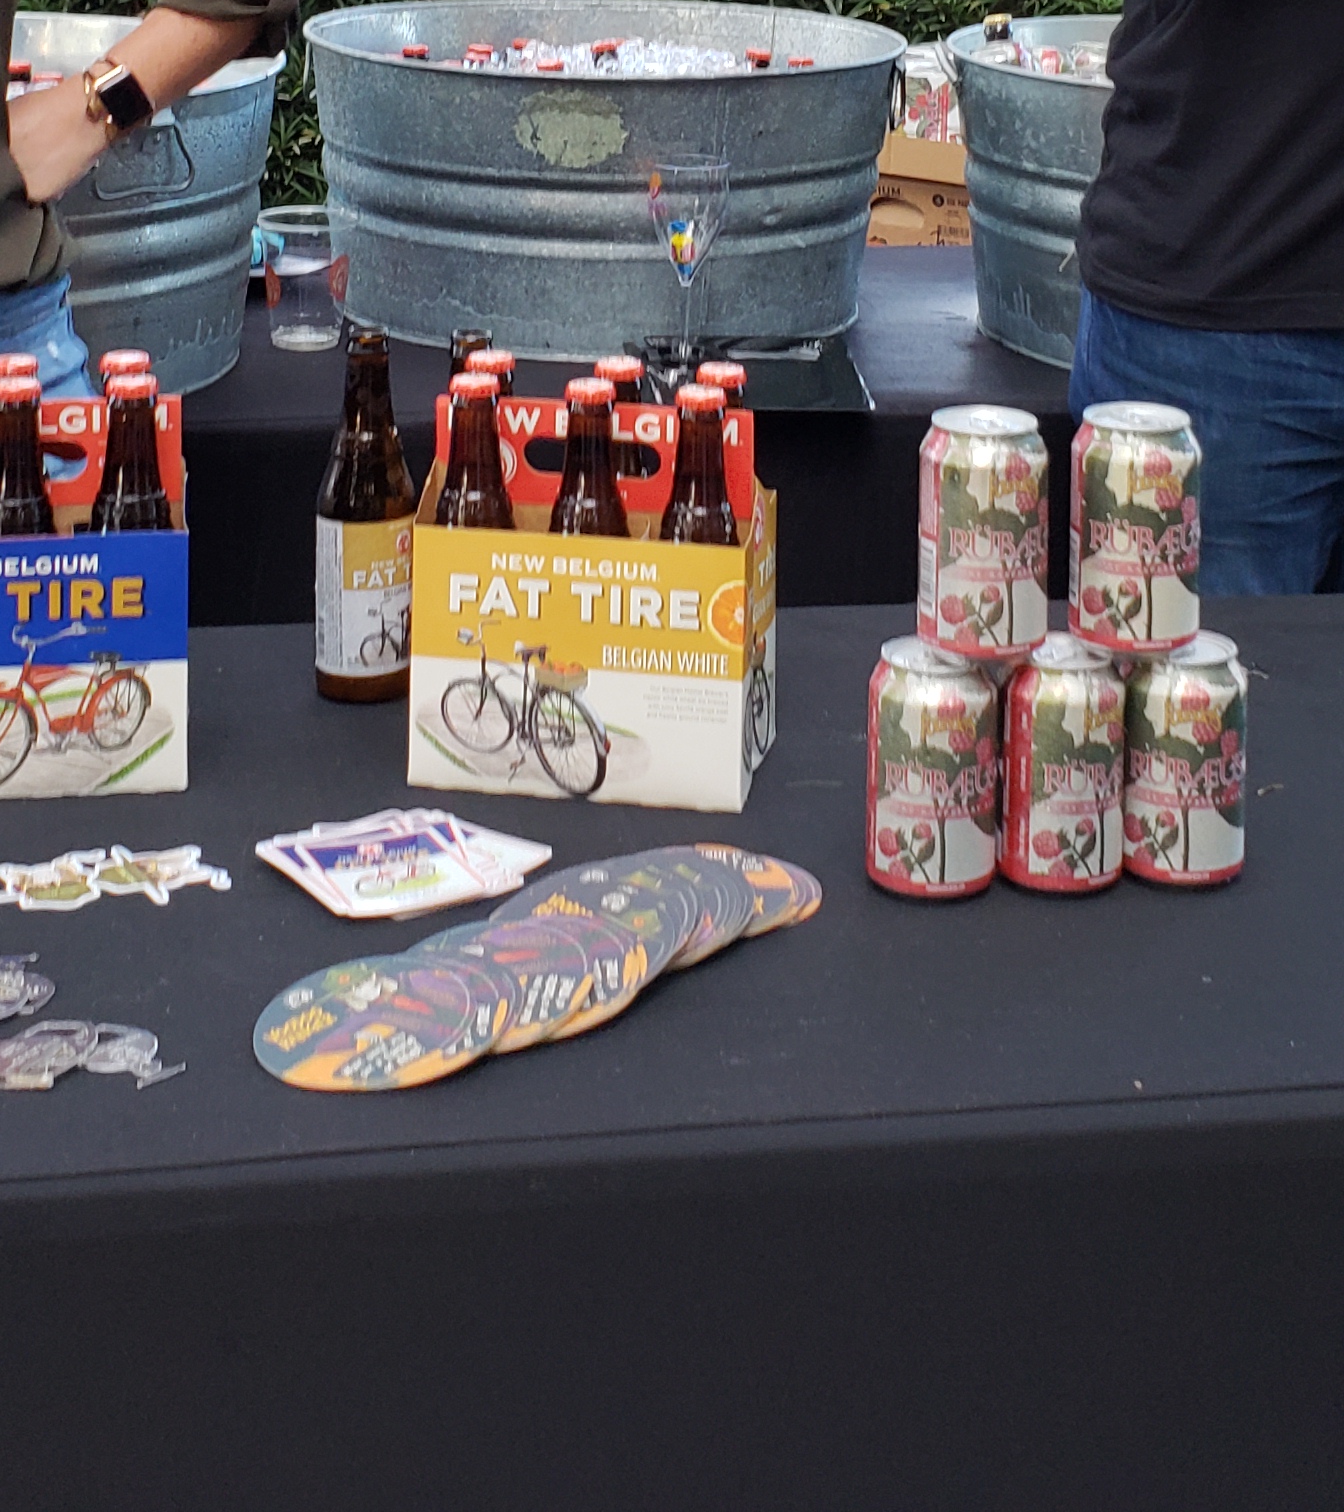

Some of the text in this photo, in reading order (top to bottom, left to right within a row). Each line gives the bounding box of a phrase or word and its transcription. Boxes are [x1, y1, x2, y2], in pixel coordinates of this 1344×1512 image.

[352, 566, 397, 590] FAT
[491, 552, 658, 583] NEW BELGIUM
[6, 576, 145, 622] TIRE
[448, 572, 551, 619] FAT
[570, 580, 702, 631] TIRE
[602, 645, 729, 676] BELGIAN WHITE
